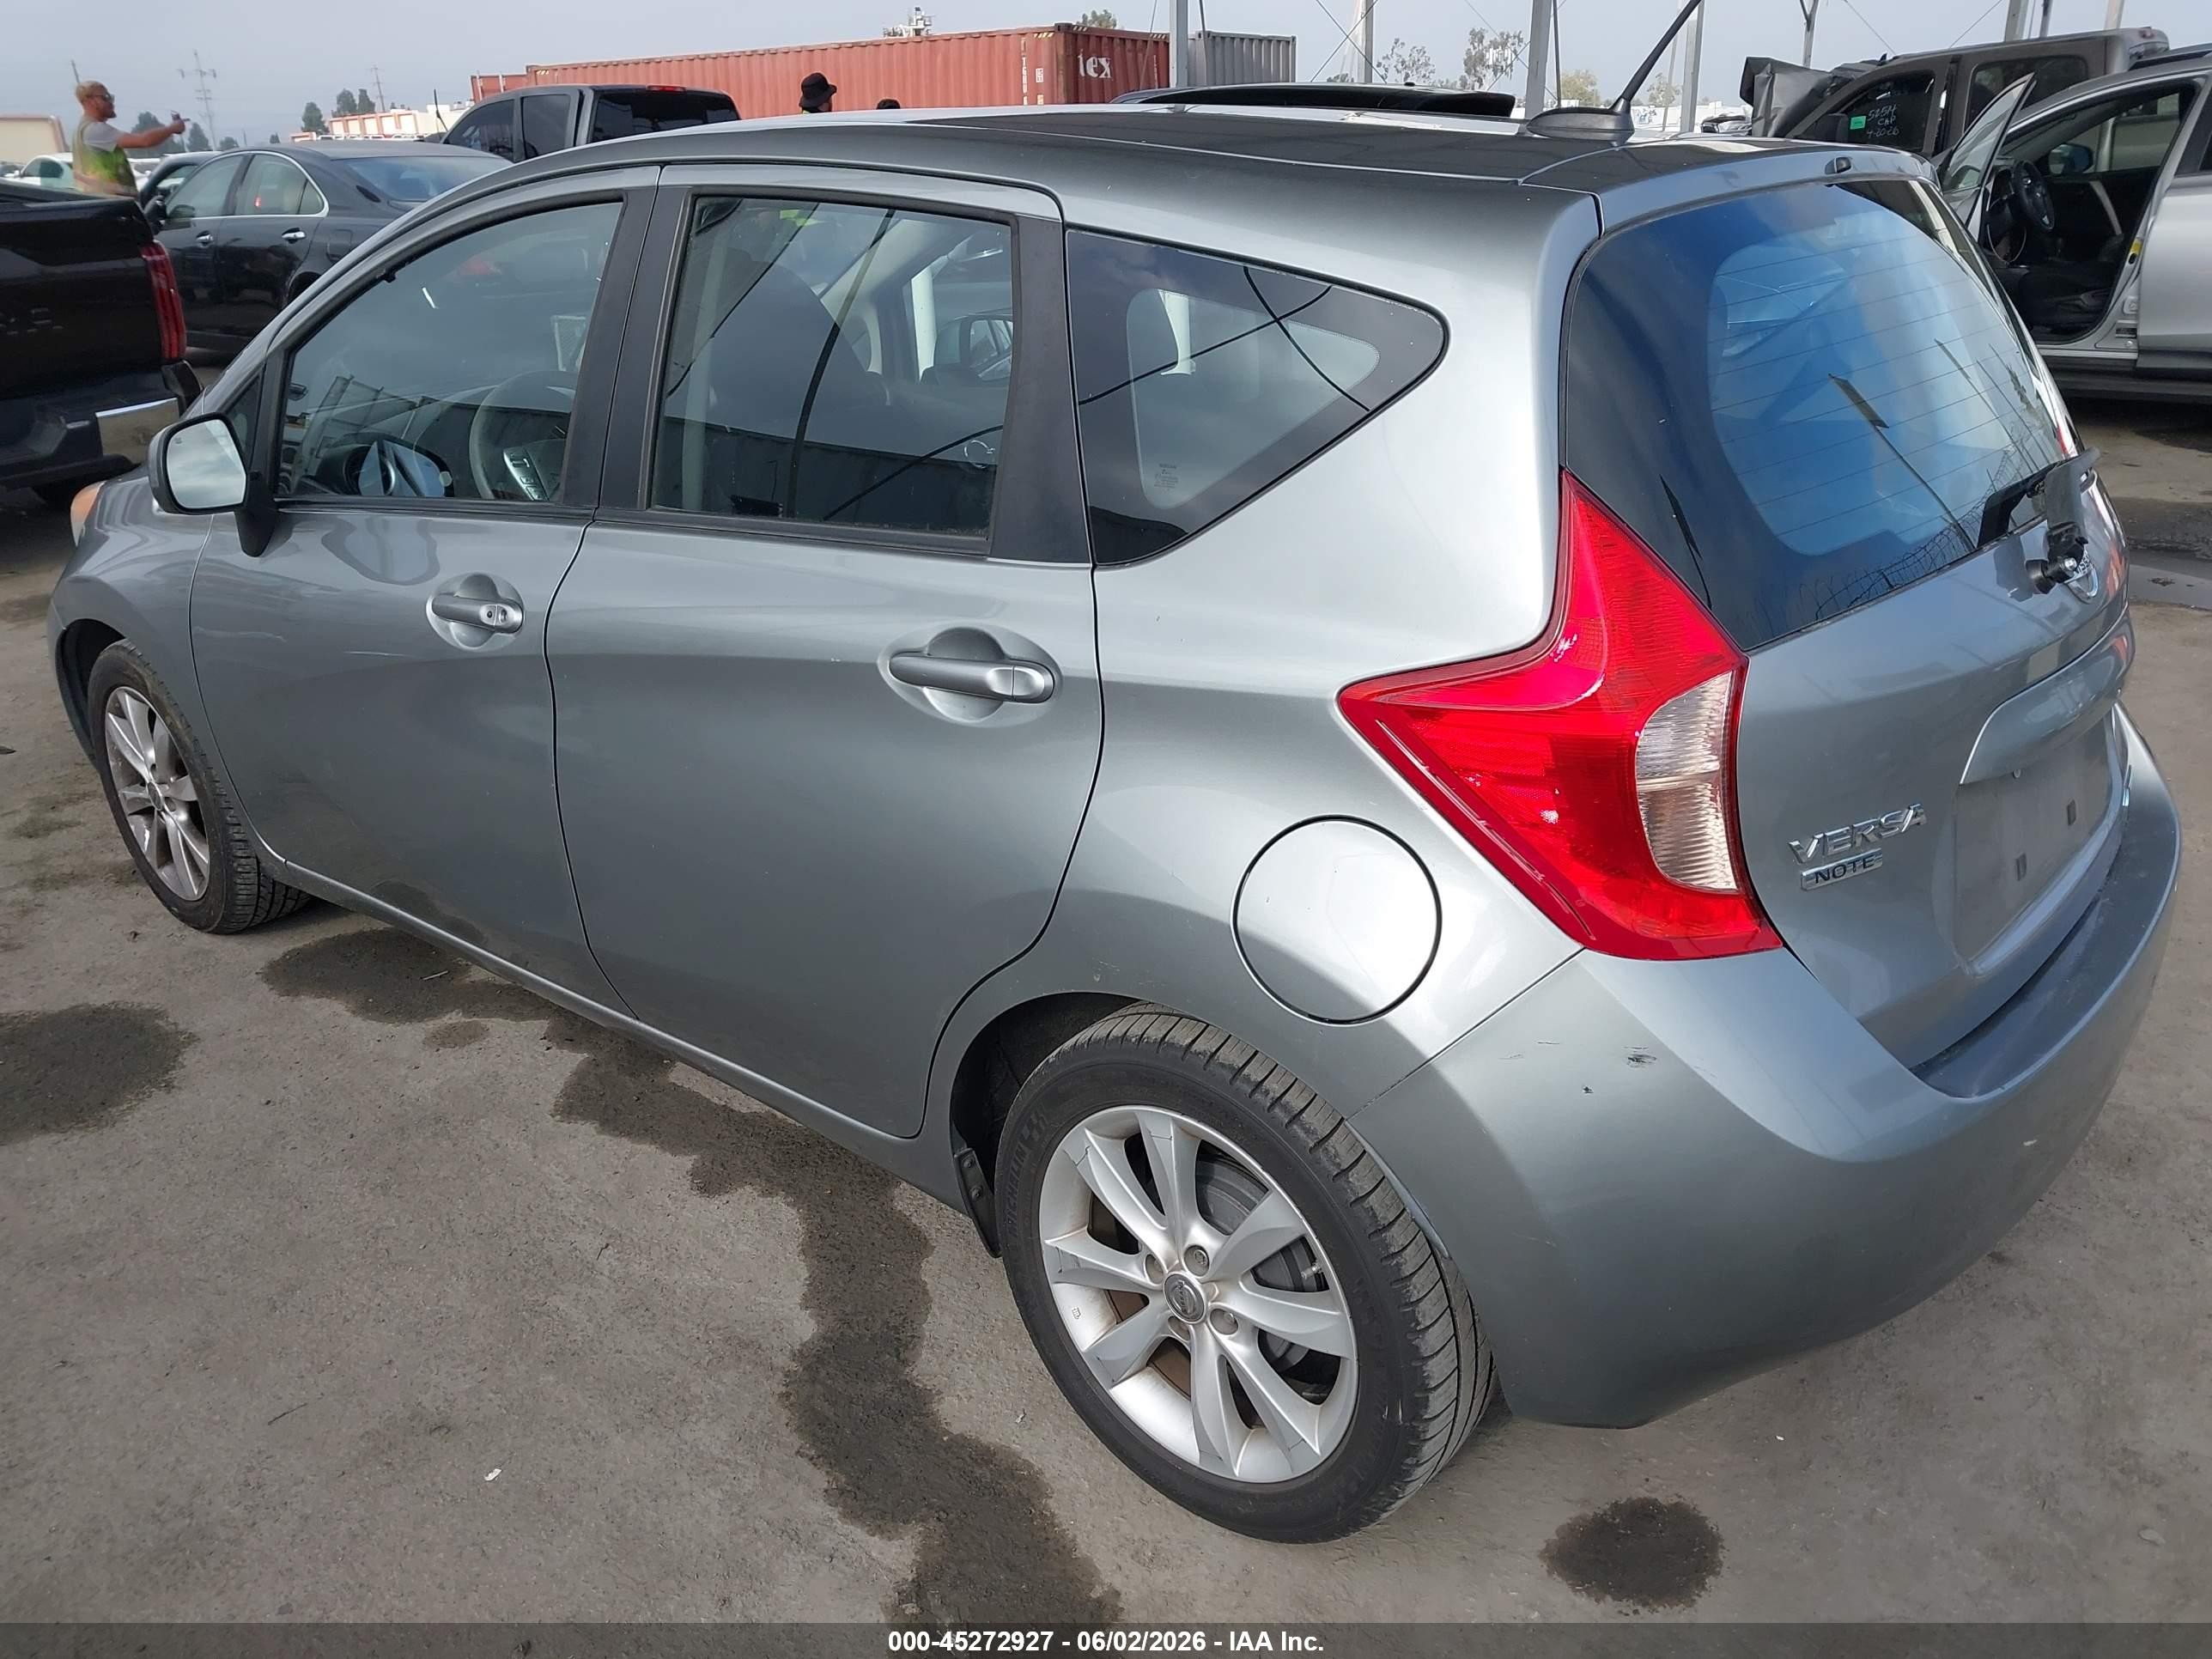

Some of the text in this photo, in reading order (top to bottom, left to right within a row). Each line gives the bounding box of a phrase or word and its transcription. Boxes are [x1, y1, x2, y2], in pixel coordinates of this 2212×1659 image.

[1787, 803, 1927, 865] VERSA
[1814, 855, 1876, 884] NOTE
[1006, 1140, 1031, 1237] MICHELIN
